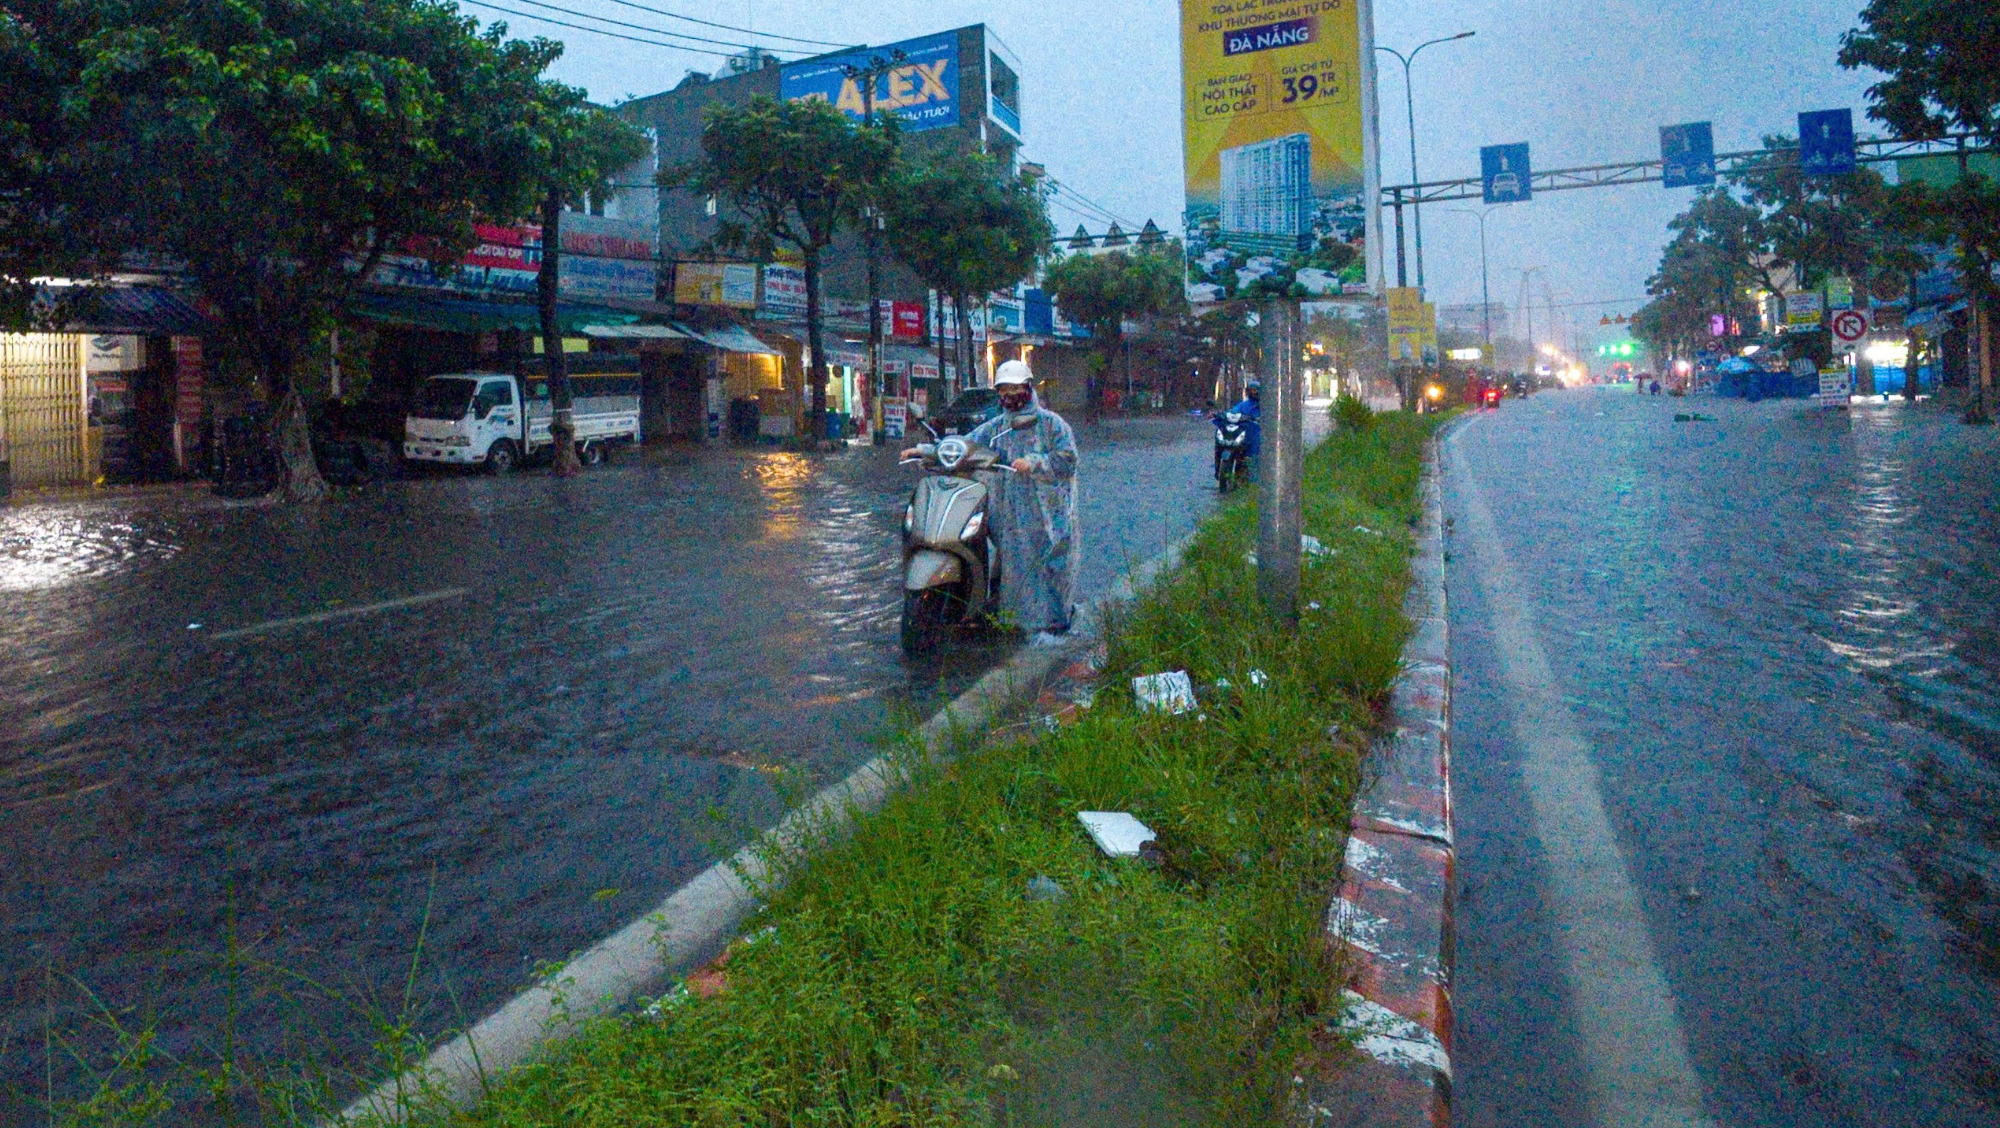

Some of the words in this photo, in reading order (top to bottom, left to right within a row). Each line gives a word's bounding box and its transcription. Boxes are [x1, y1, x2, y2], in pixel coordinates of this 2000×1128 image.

[1198, 20, 1222, 32] KHU
[1229, 33, 1252, 52] ĐÀ
[1257, 24, 1309, 48] NẴNG
[836, 58, 950, 114] ALEX
[1282, 75, 1318, 103] 39
[1205, 103, 1230, 115] CAO
